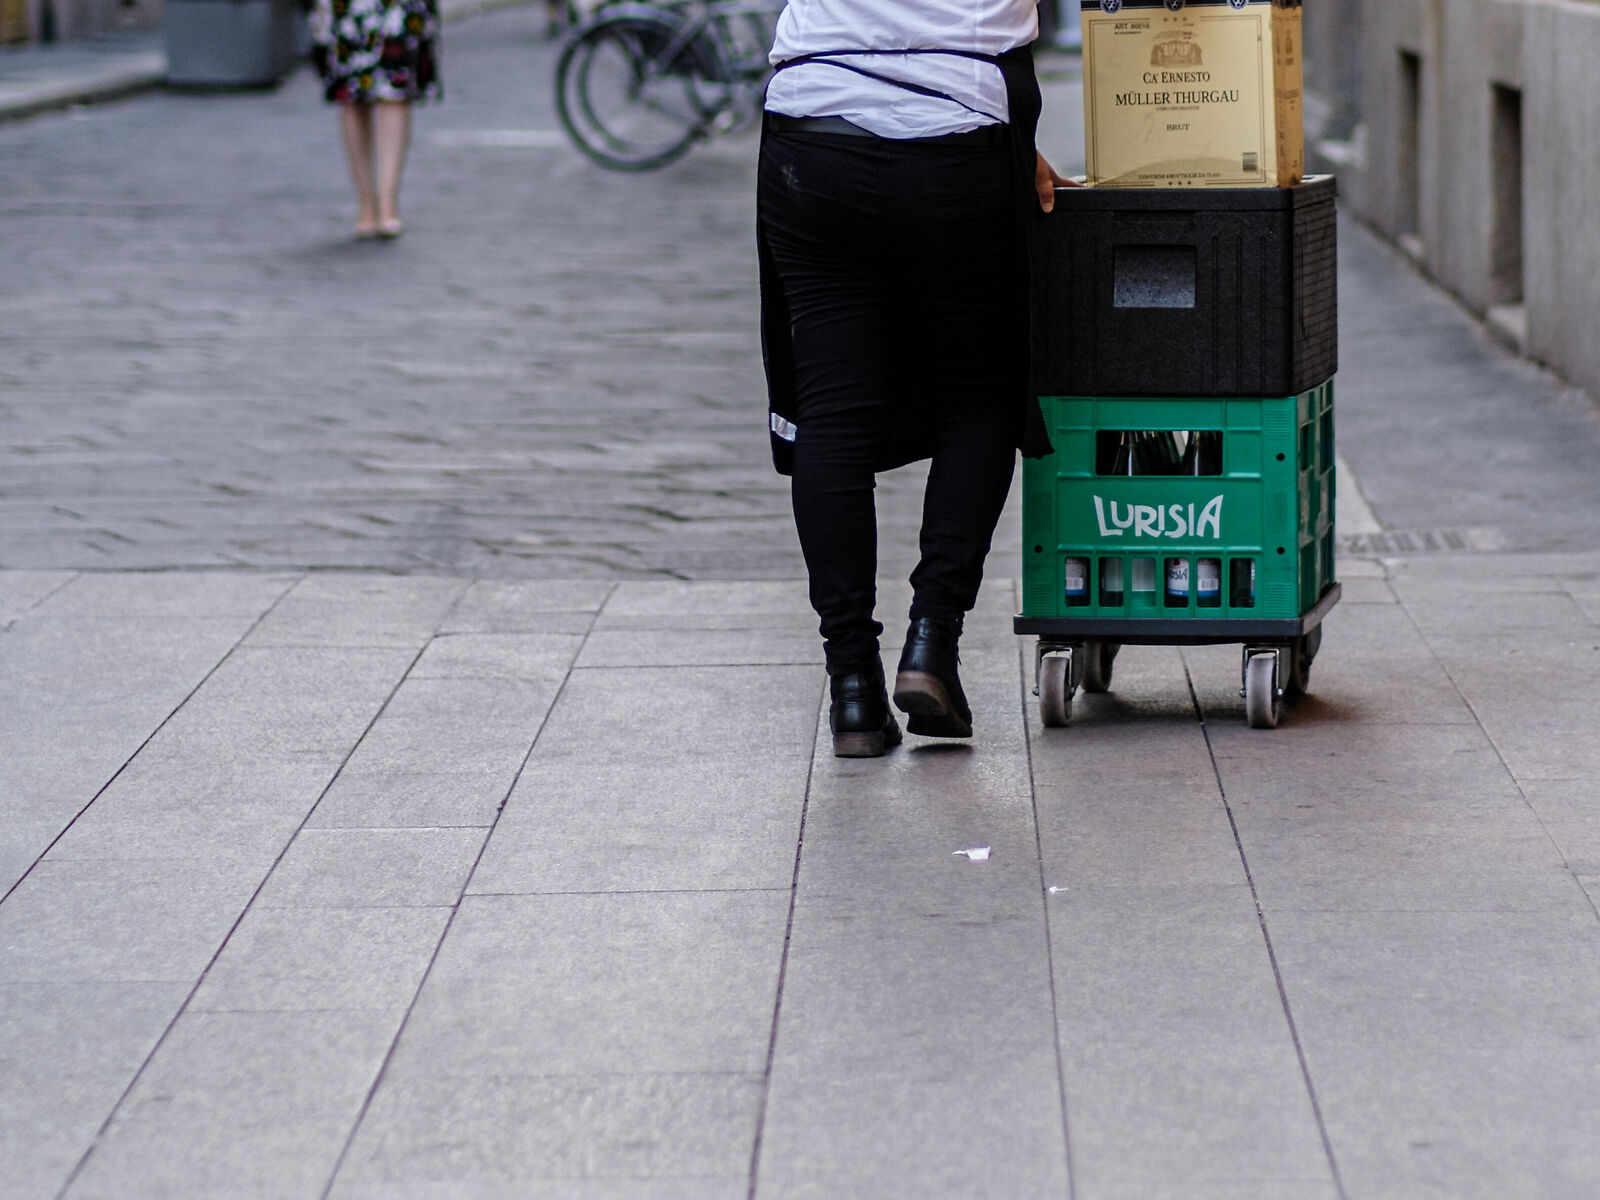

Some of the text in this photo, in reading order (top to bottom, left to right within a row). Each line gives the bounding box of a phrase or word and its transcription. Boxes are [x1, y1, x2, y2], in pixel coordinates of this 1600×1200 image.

[1161, 71, 1211, 83] ERNESTO
[1115, 90, 1239, 106] MÜLLER THURGAU
[1166, 123, 1190, 131] BRUT
[1093, 494, 1224, 539] LURISIA
